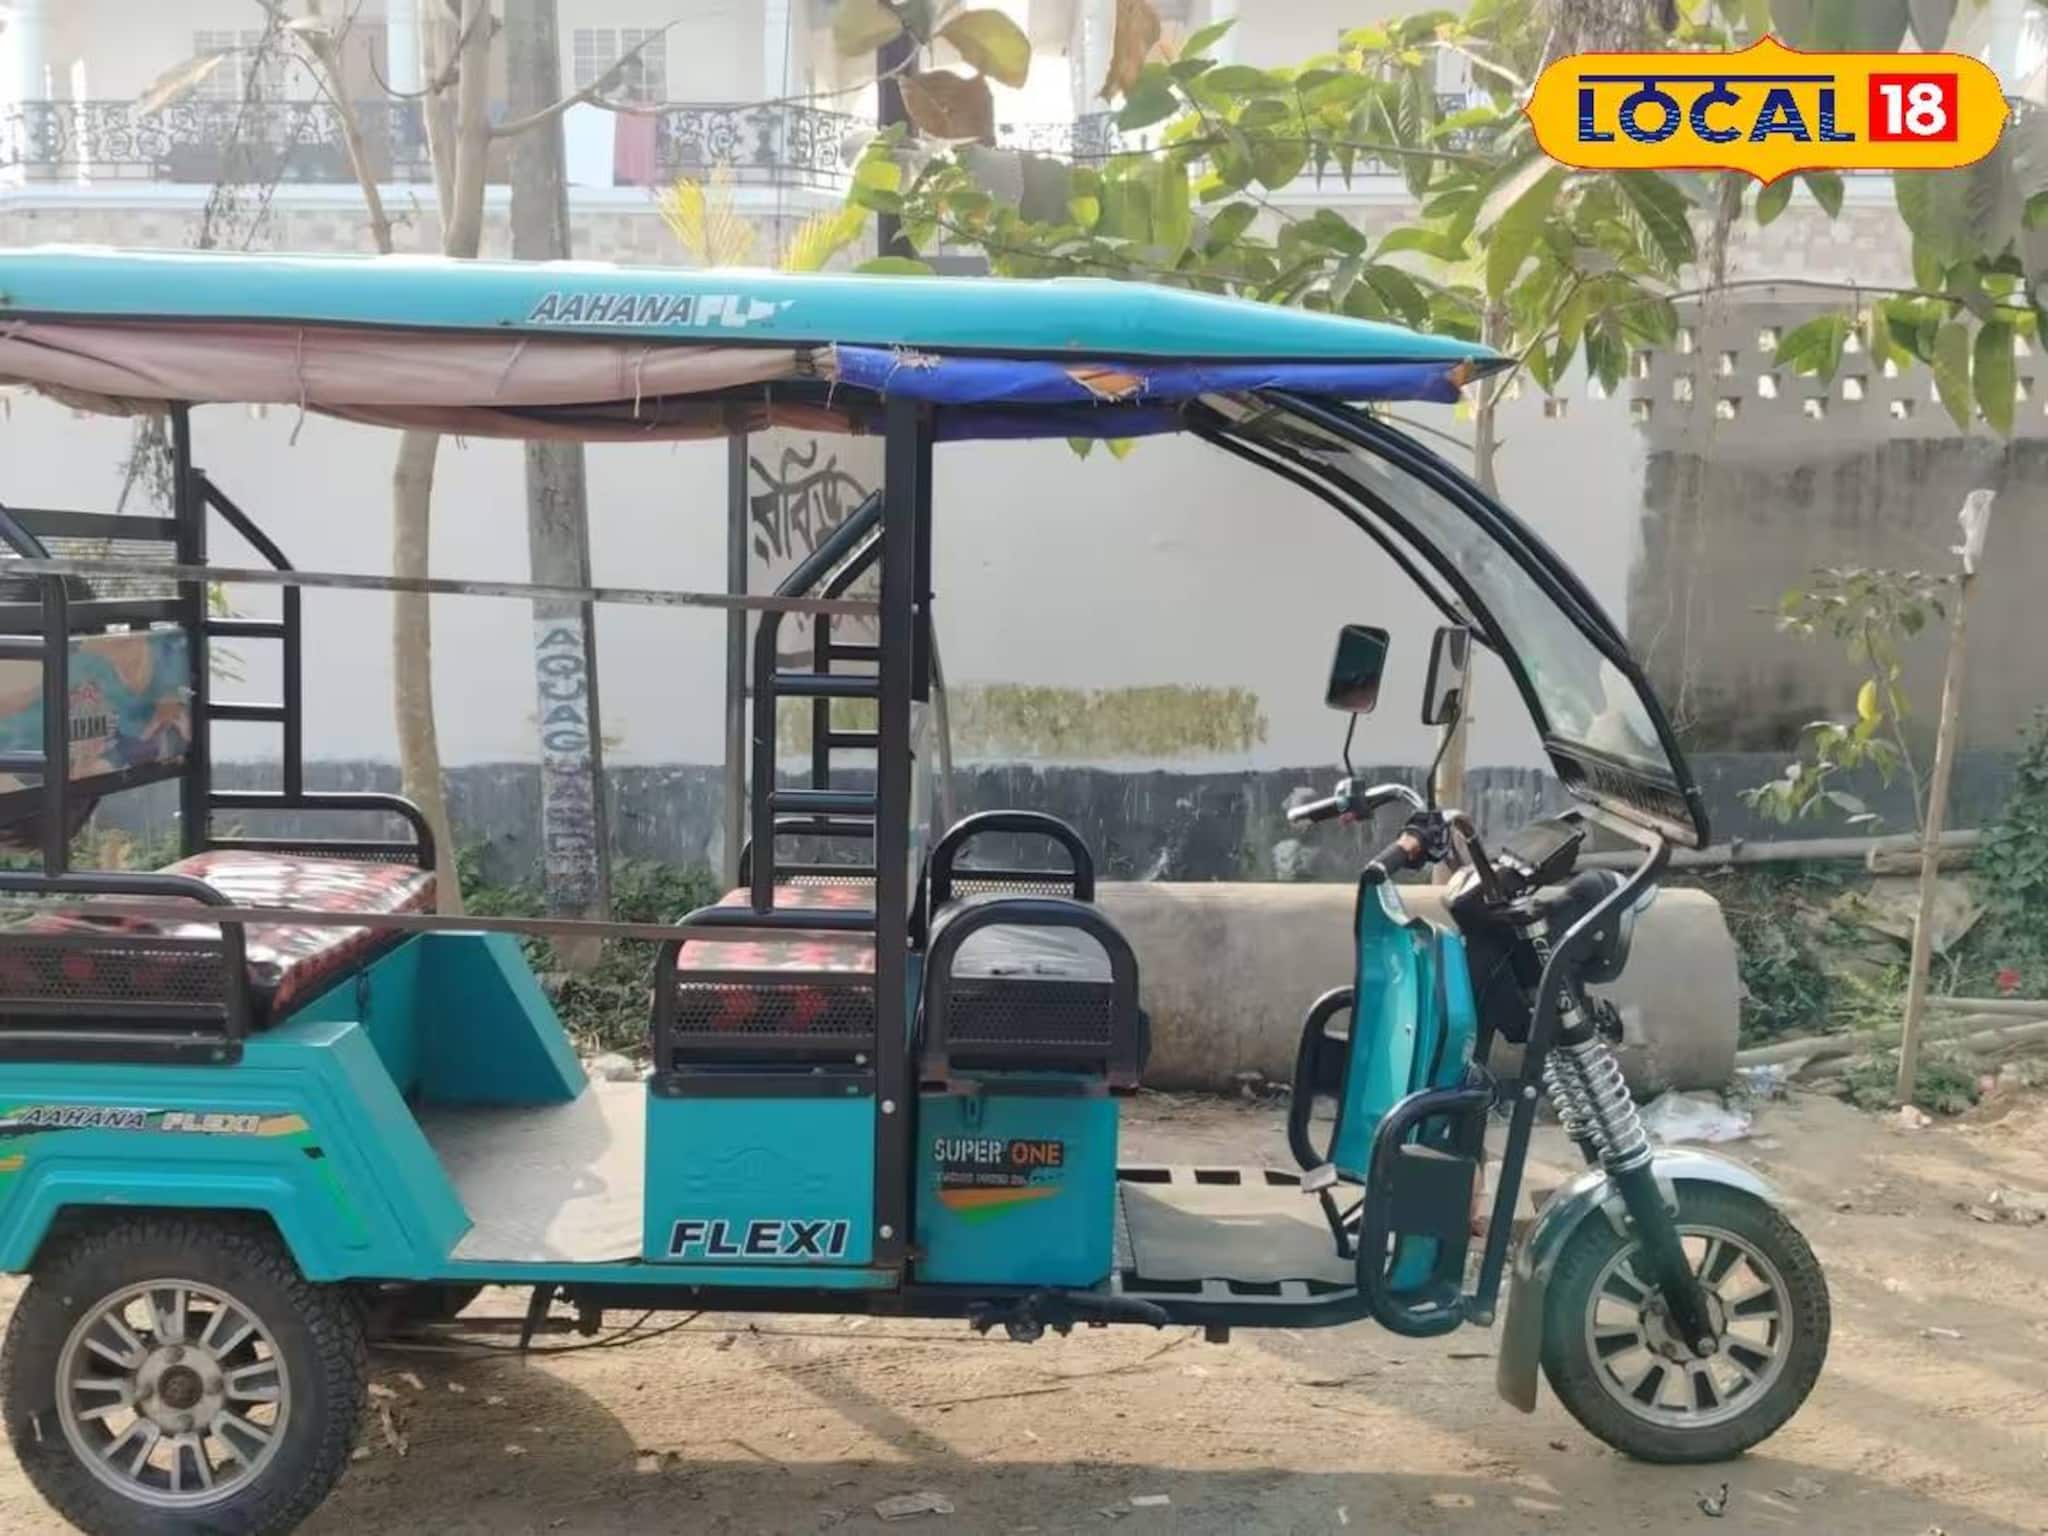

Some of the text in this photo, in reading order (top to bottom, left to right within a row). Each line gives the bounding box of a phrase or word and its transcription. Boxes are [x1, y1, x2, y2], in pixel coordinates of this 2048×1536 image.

[526, 290, 694, 326] AAHANA
[19, 1106, 147, 1129] AAHANA
[934, 1139, 1061, 1165] SUPER ONE
[668, 1219, 851, 1257] FLEXI
